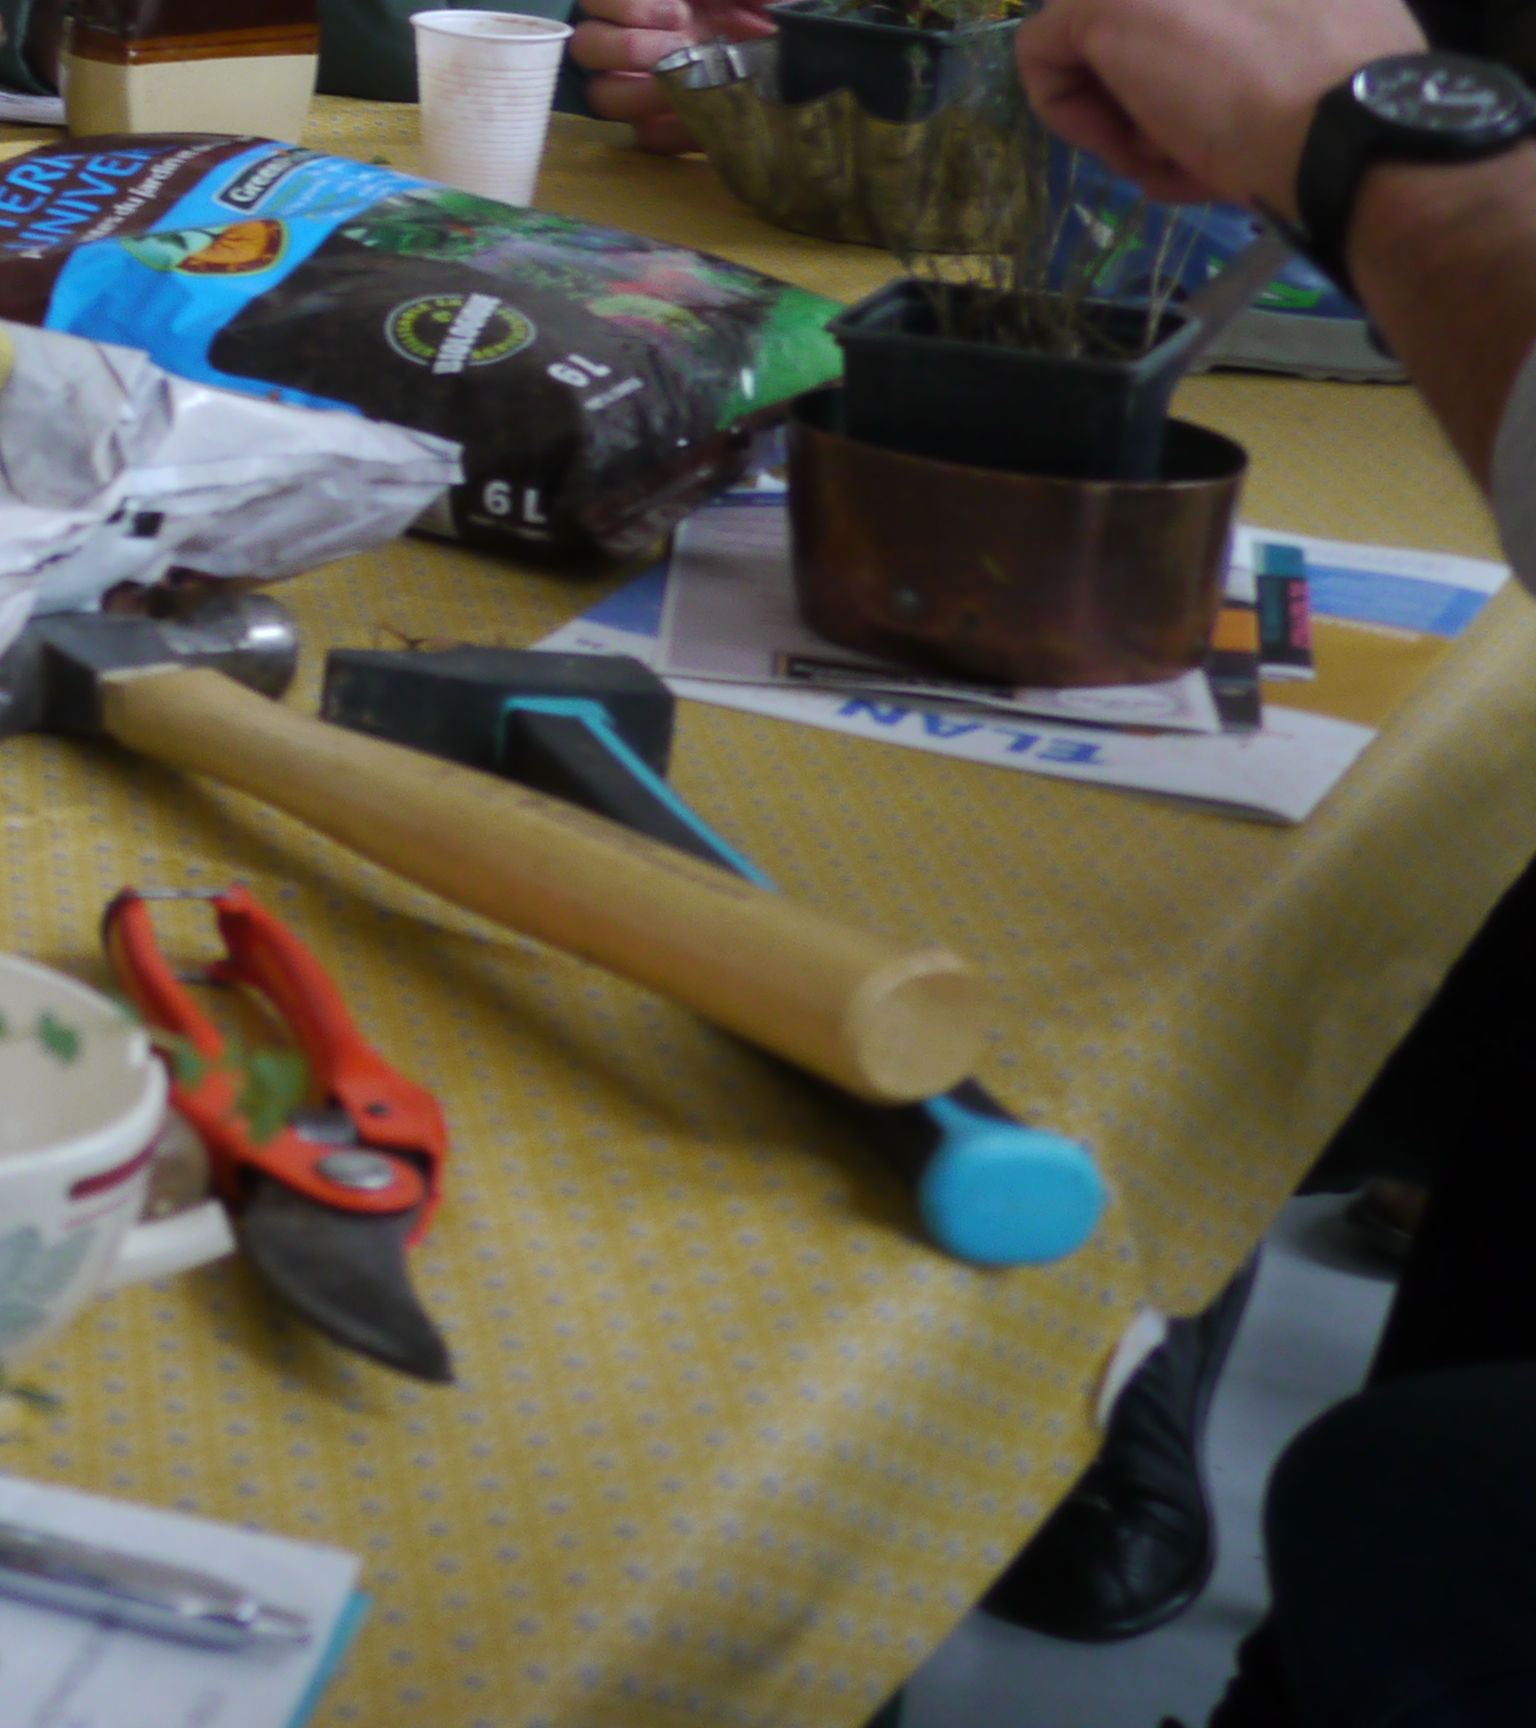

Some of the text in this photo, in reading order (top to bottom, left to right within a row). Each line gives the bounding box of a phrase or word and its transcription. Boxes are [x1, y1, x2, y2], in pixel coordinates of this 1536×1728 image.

[482, 478, 548, 524] 6 L
[836, 695, 1105, 767] ELAN
